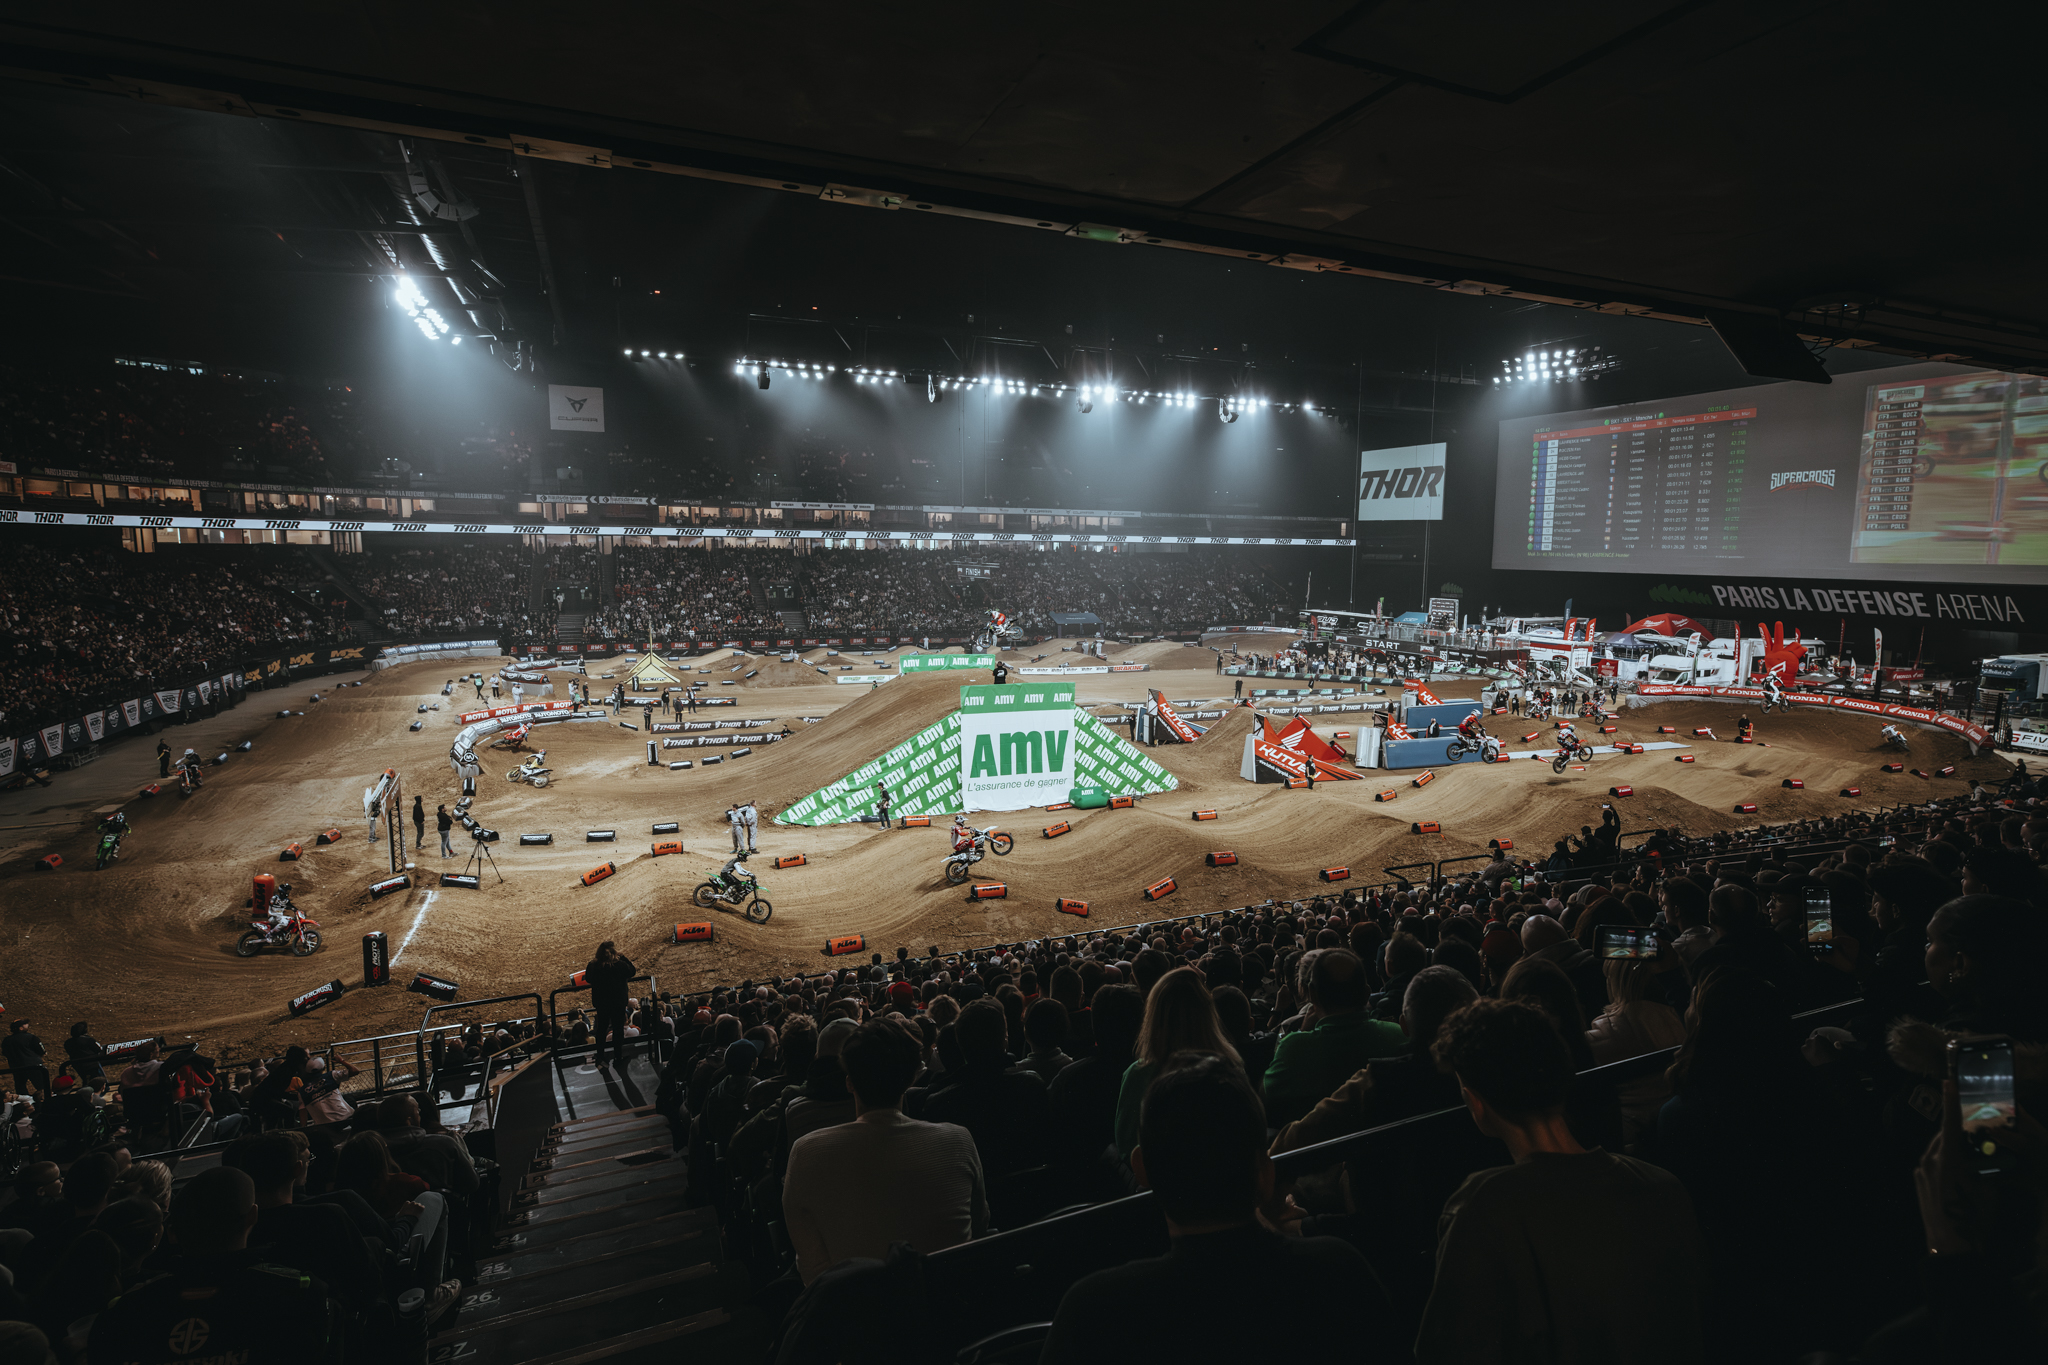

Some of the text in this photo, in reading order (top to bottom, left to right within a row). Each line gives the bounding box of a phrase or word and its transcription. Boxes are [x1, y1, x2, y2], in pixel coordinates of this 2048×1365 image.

[1360, 465, 1445, 500] THOR
[1770, 469, 1836, 491] SUPERCROSS
[0, 511, 18, 522] HOR
[35, 512, 64, 523] THOR
[87, 515, 114, 525] THOR
[140, 517, 173, 526] THOR
[201, 519, 235, 528] THOR
[265, 520, 300, 529] THOR
[329, 522, 364, 530] THOR
[392, 523, 427, 531] THOR
[453, 524, 487, 532] THOR
[513, 525, 545, 533] THOR
[570, 526, 600, 534] THOR
[676, 528, 704, 536] THOR
[774, 530, 801, 538] THOR
[910, 532, 933, 540] THOR
[966, 568, 980, 576] FINISH
[1712, 584, 2025, 623] PARIS LA DEFENSE ARENA
[1365, 639, 1400, 650] START
[1727, 689, 1764, 697] HONDA
[1786, 694, 1824, 703] HONDA
[1844, 700, 1880, 711] HONDA
[466, 712, 490, 722] MOTUL
[495, 707, 518, 717] MOTUL
[1897, 708, 1930, 720] HONDA
[1100, 716, 1118, 724] THOR
[1942, 720, 1964, 731] HONDA
[670, 738, 694, 746] THOR
[704, 736, 729, 744] THOR
[967, 777, 1068, 792] L'assurance de gagner
[659, 842, 678, 850] KTM
[589, 867, 606, 880] KTM
[1066, 902, 1084, 910] KTM
[682, 926, 706, 936] KTM
[836, 940, 857, 948] KTM
[432, 982, 453, 990] MOTO
[293, 982, 333, 1008] SUPERCROSS
[499, 1234, 520, 1245] 24
[482, 1264, 506, 1276] 25
[465, 1291, 493, 1306] 26
[436, 1341, 468, 1360] 27
